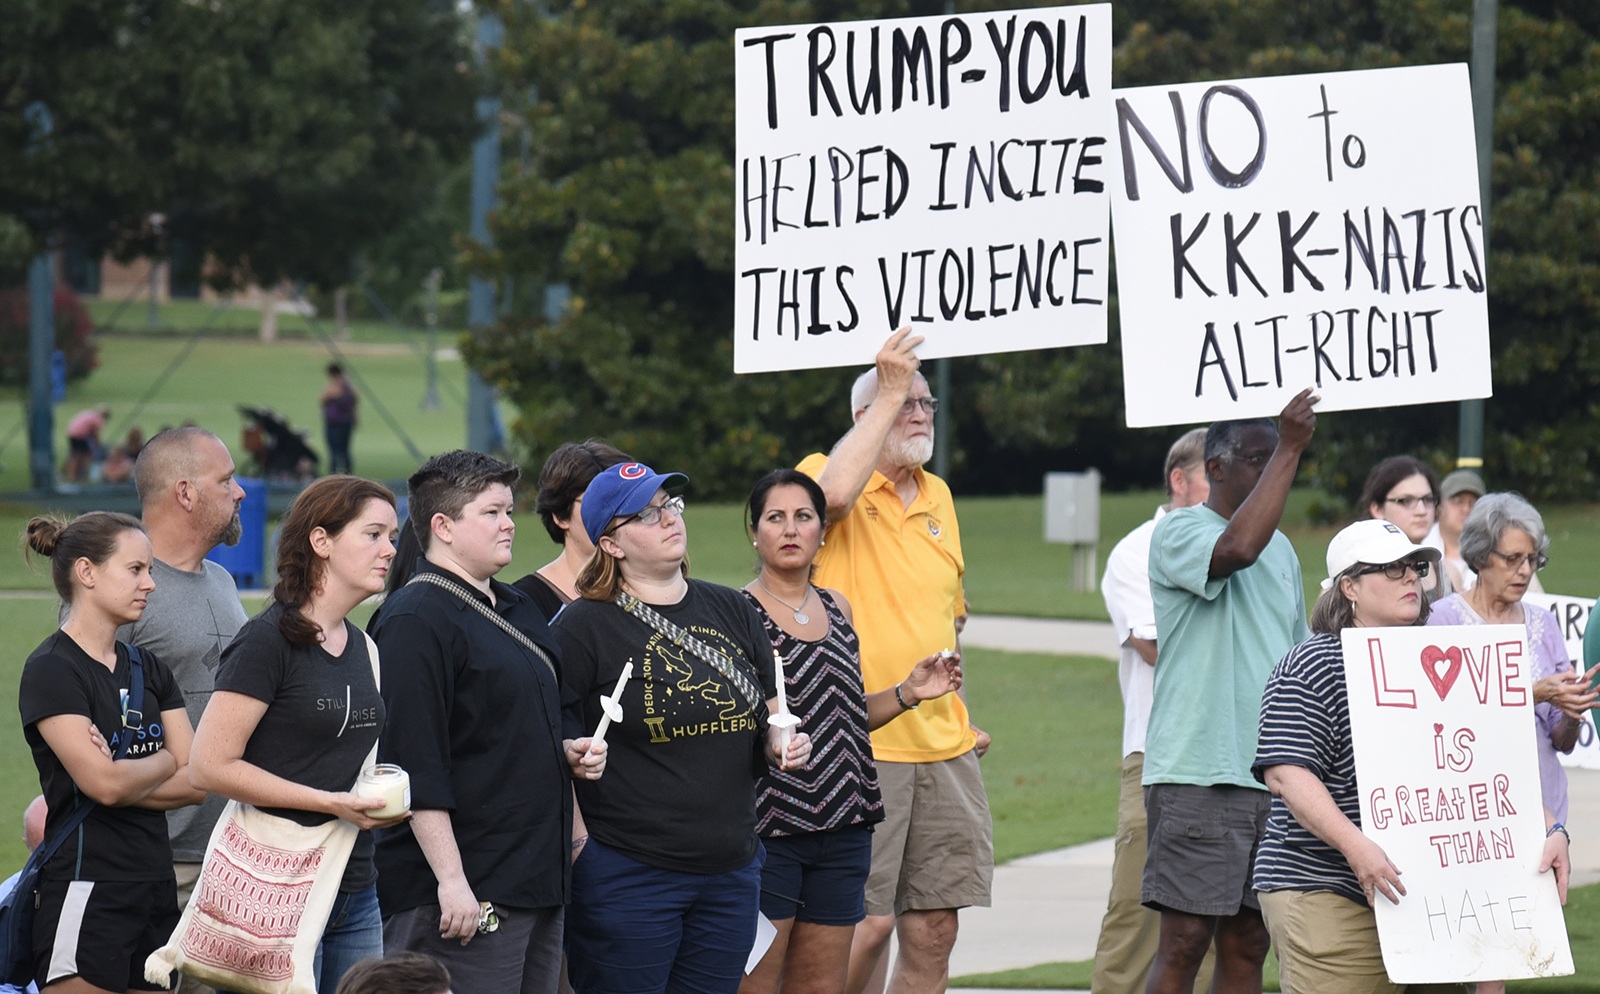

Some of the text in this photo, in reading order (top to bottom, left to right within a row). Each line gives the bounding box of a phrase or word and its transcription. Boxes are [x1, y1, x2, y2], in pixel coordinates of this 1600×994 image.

[1115, 84, 1268, 201] NO
[743, 137, 1107, 245] HELPED INCITE
[741, 238, 1103, 341] THIS VIOLENCE
[1195, 305, 1444, 402] ALT-RIGHT
[619, 462, 647, 480] C
[316, 698, 346, 711] STILL
[352, 708, 376, 721] RISE
[672, 718, 757, 738] HUFFLEPU
[1430, 827, 1515, 867] THAN
